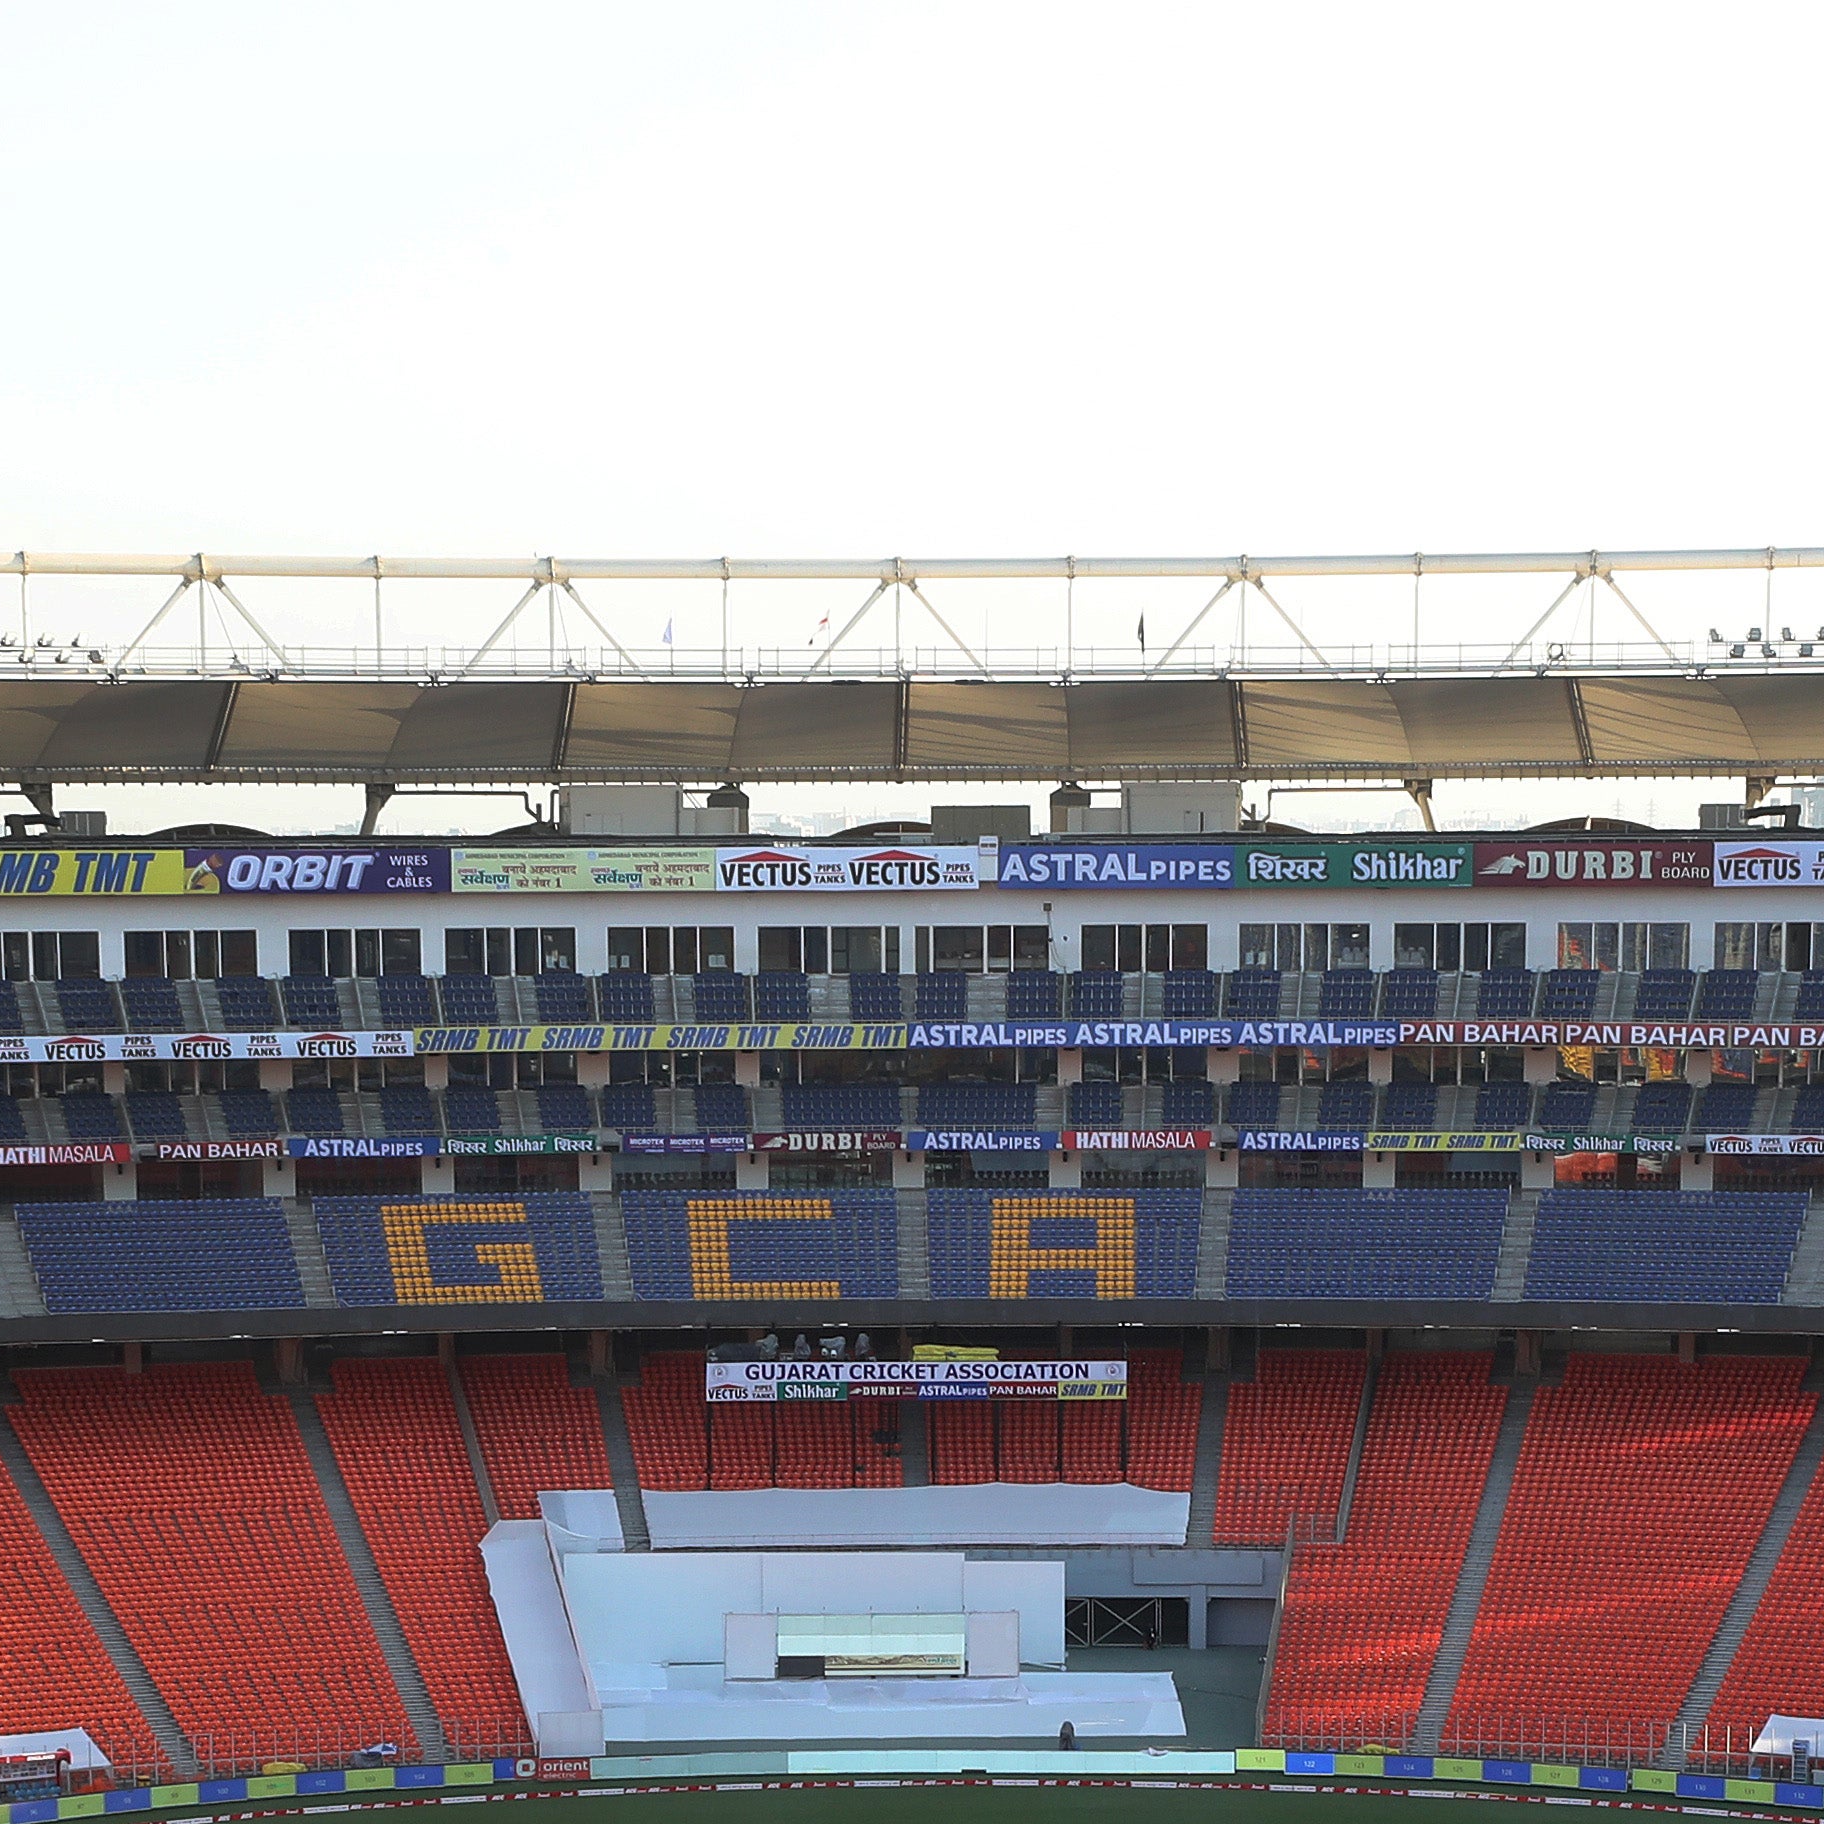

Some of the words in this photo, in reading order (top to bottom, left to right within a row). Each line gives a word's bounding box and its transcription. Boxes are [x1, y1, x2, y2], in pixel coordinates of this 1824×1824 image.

[389, 855, 428, 866] WIRES
[1353, 852, 1462, 880] Shikhar
[1526, 850, 1653, 878] DURBI
[1672, 852, 1696, 864] PLY
[72, 853, 155, 893] TMT
[226, 854, 375, 891] ORBIT
[404, 867, 414, 878] &
[720, 863, 812, 887] VECTUS
[817, 863, 842, 872] PIPES
[850, 861, 940, 885] VECTUS
[946, 863, 971, 872] PIPES
[1000, 853, 1146, 881] ASTRAL
[1151, 860, 1231, 880] PIPES
[1248, 854, 1328, 880] शिखर
[1661, 866, 1709, 879] BOARD
[1719, 858, 1801, 880] VECTUS
[386, 876, 433, 888] CABLES
[815, 875, 845, 884] TANKS
[943, 874, 975, 884] TANKS
[416, 1029, 478, 1052] SRMB
[485, 1029, 531, 1050] TMT
[791, 1026, 854, 1048] SRMB
[861, 1025, 906, 1047] TMT
[909, 1025, 1013, 1047] ASTRAL
[1015, 1029, 1067, 1046] PIPES
[1074, 1024, 1177, 1046] ASTRAL
[1179, 1028, 1232, 1045] PIPES
[1399, 1024, 1454, 1044] PAN
[1465, 1024, 1557, 1044] BAHAR
[1733, 1026, 1790, 1047] PAN
[789, 1133, 862, 1150] DURBI
[1242, 1132, 1315, 1149] ASTRAL
[1317, 1136, 1360, 1149] PIPES
[1708, 1140, 1753, 1154] VECTUS
[49, 1146, 114, 1163] MASALA
[744, 1363, 844, 1382] GUJARAT
[848, 1363, 938, 1381] CRICKET
[944, 1362, 1090, 1380] ASSOCIATION
[707, 1388, 749, 1401] VECTUS
[783, 1382, 839, 1399] Shikhar
[862, 1385, 900, 1396] DURBI
[918, 1385, 962, 1396] ASTRAL
[963, 1388, 987, 1397] PIPES
[989, 1385, 1012, 1395] PAN
[1015, 1385, 1057, 1395] BAHAR
[1061, 1383, 1097, 1397] SRMB
[1100, 1383, 1125, 1397] TMT
[543, 1759, 589, 1772] orient
